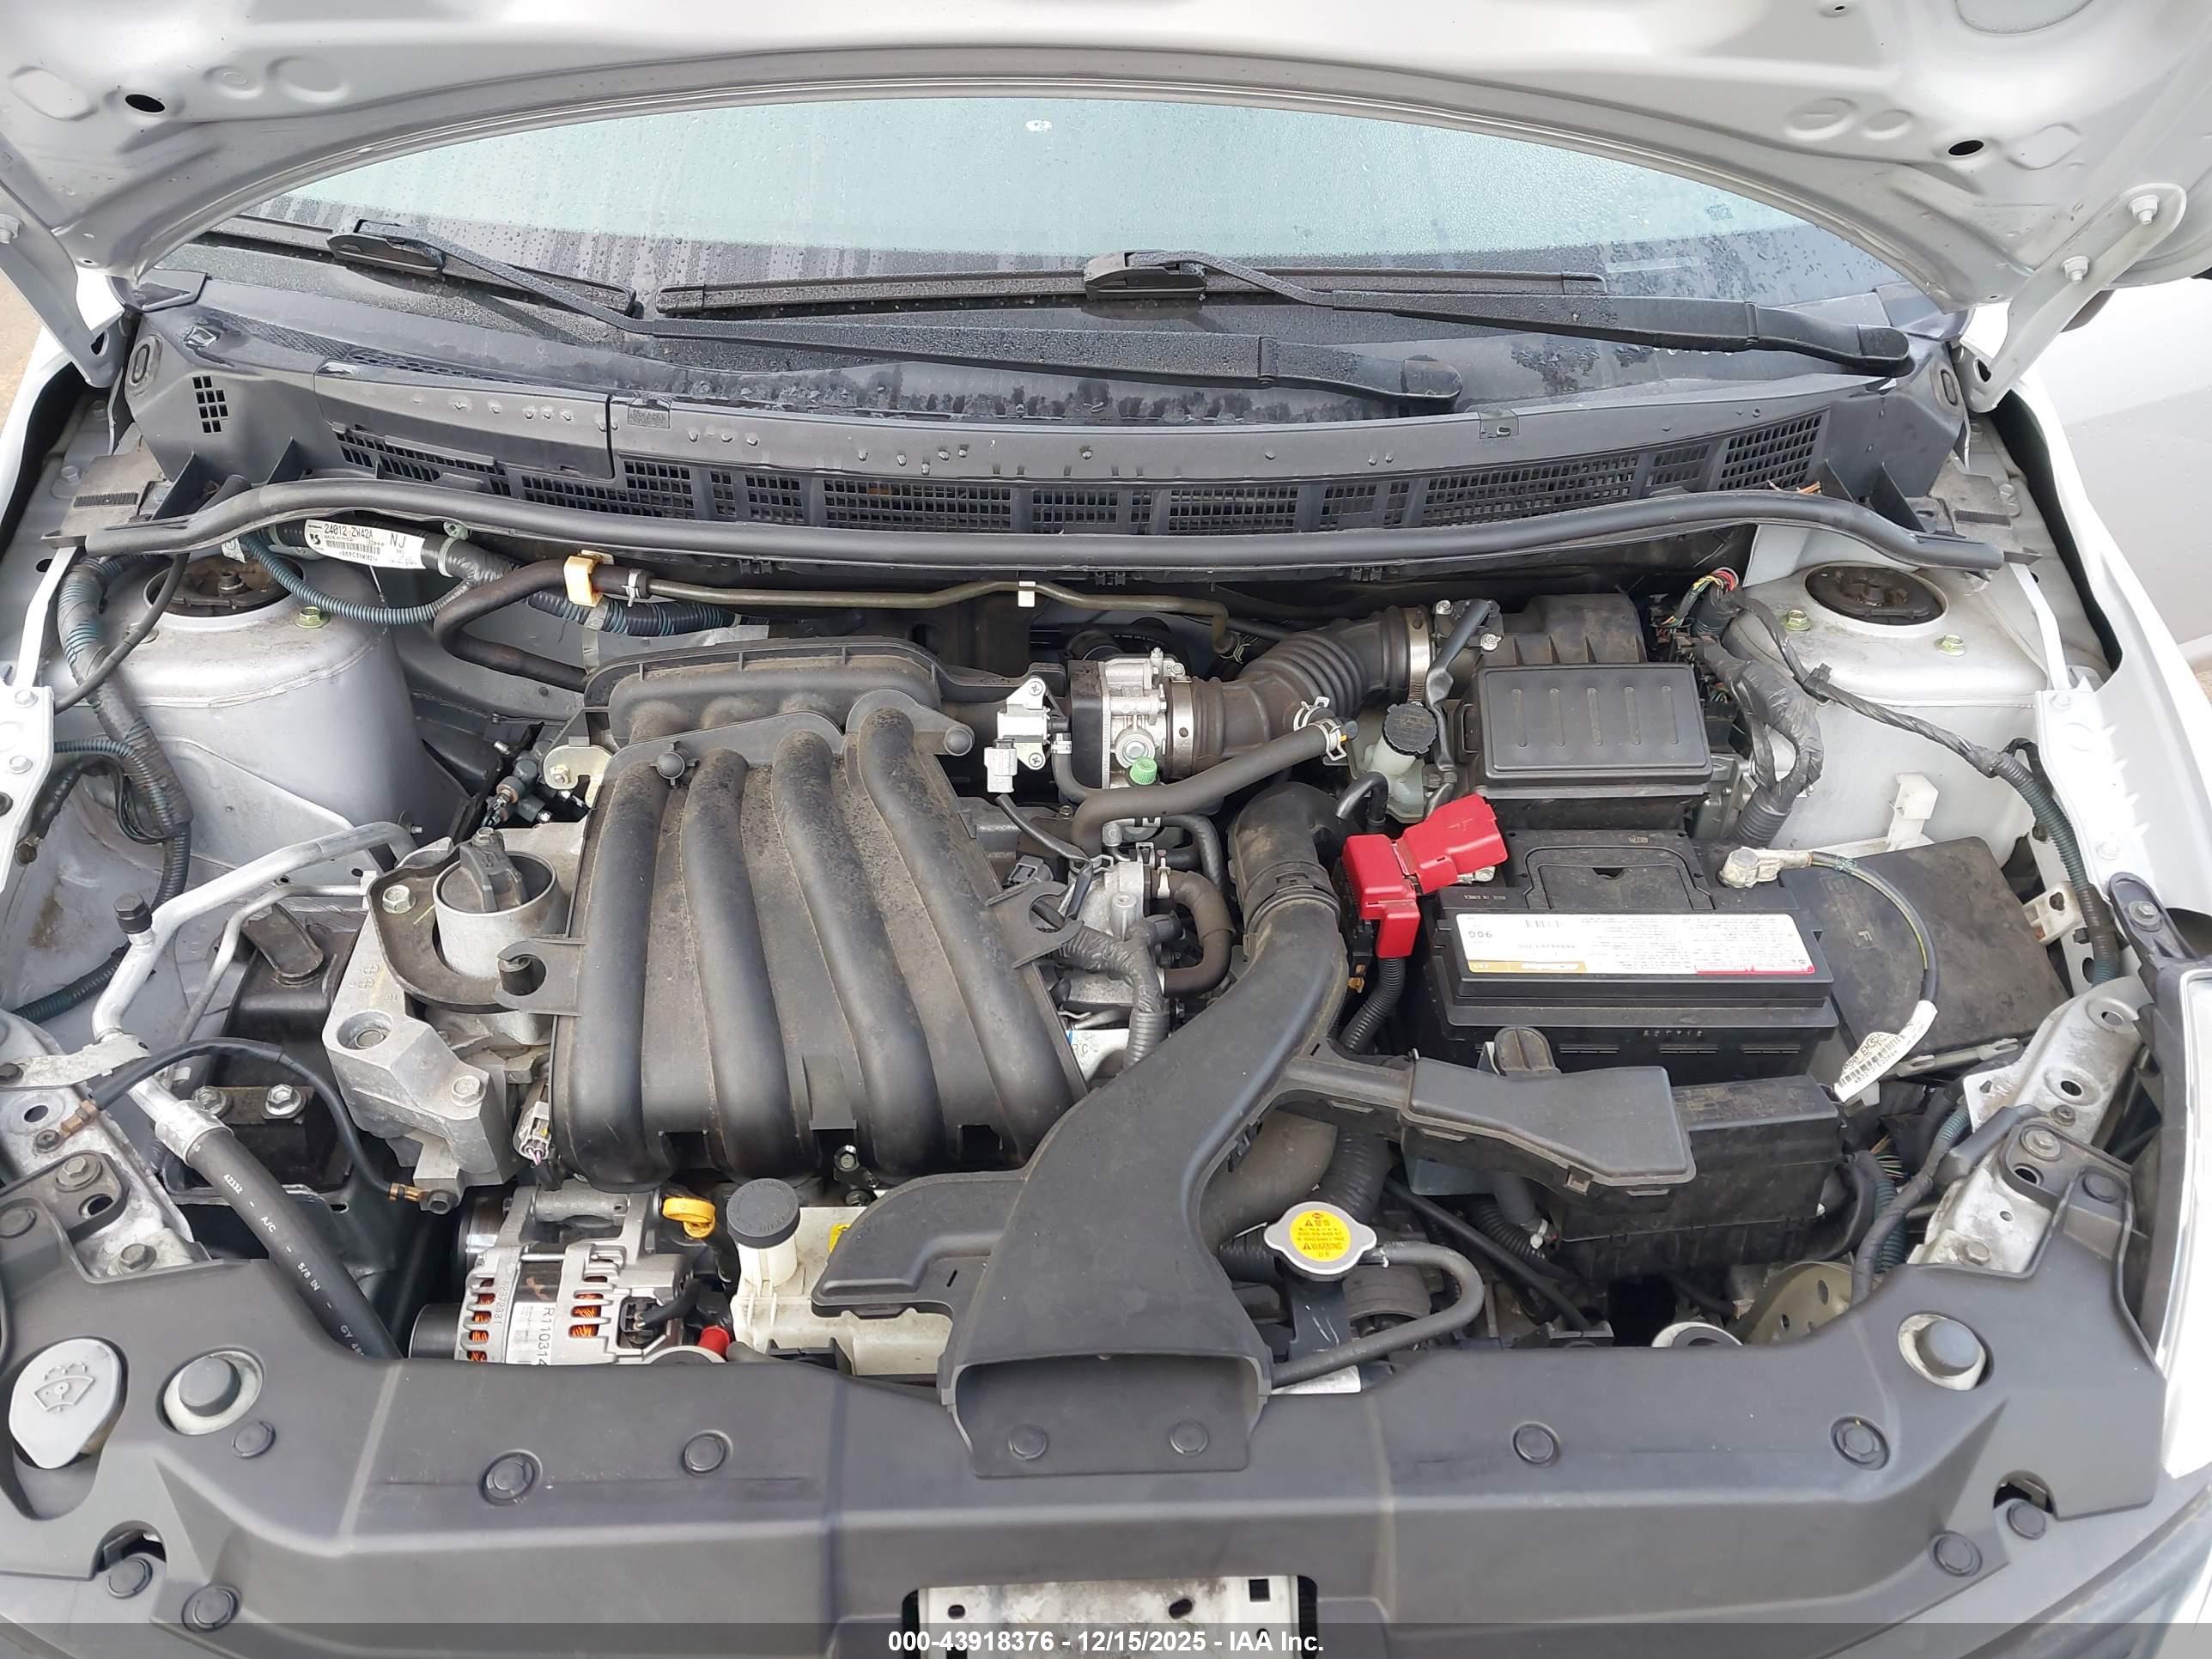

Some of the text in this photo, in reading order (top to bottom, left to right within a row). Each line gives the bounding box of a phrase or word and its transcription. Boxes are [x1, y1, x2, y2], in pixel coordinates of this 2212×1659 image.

[324, 523, 348, 537] 24012
[260, 1216, 276, 1233] A/C
[296, 1262, 311, 1279] 5/8
[310, 1279, 320, 1291] IN
[340, 1325, 353, 1339] GY
